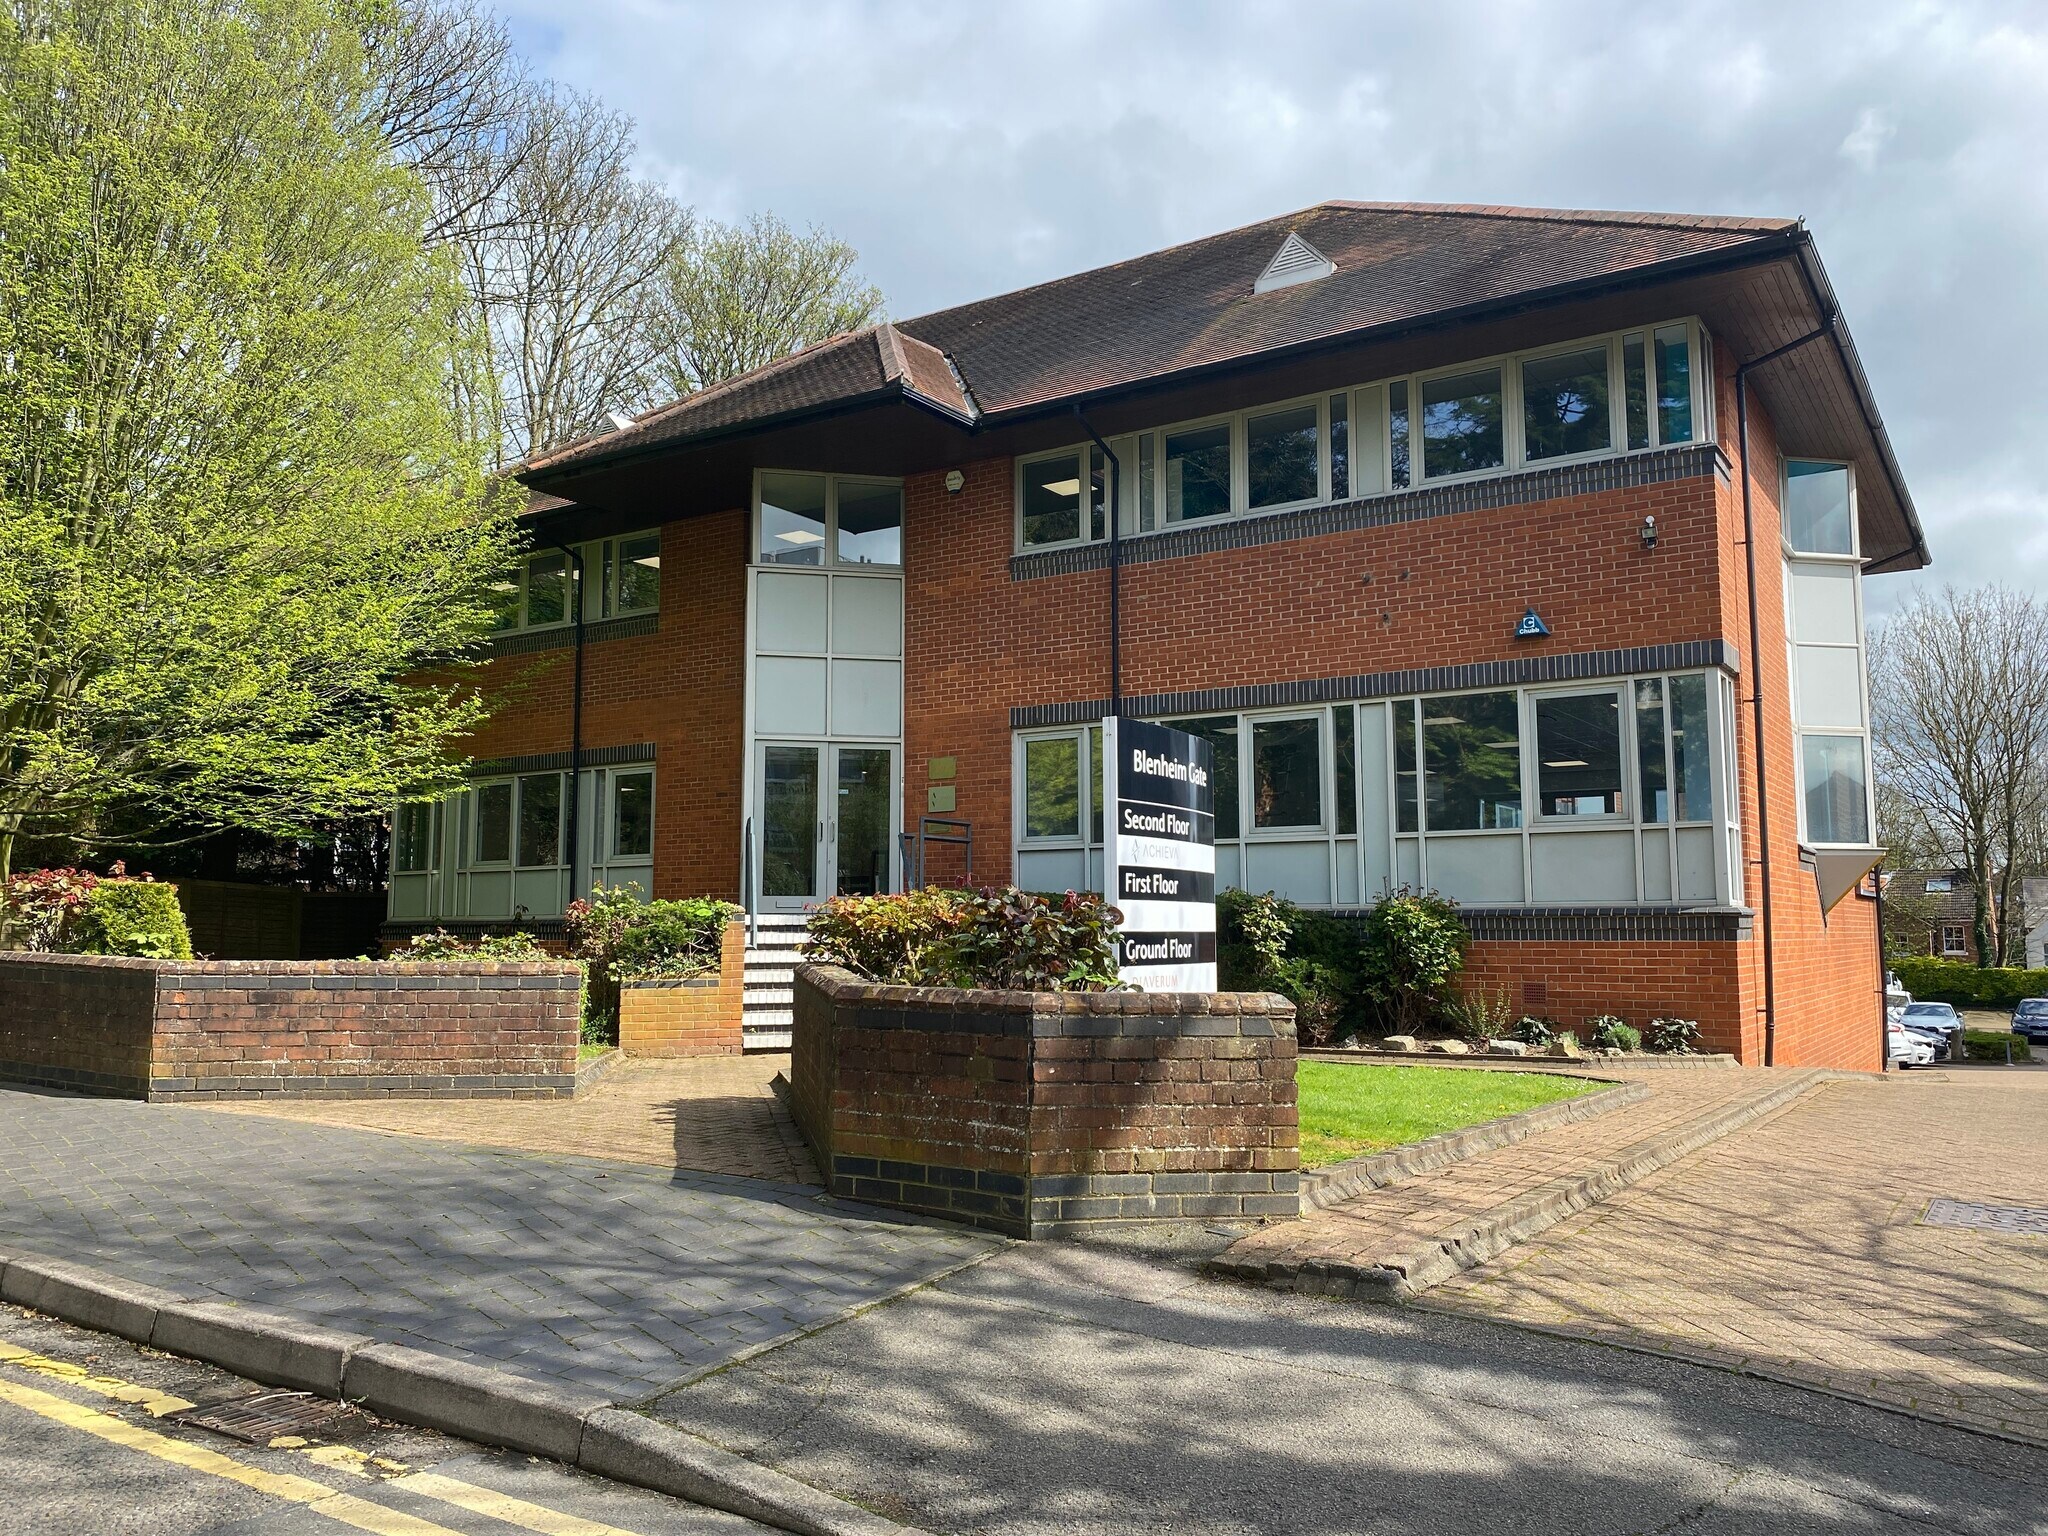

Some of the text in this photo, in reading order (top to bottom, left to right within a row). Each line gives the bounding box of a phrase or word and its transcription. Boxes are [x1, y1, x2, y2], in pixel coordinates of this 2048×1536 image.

[1519, 627, 1540, 635] Chubb
[1133, 748, 1207, 787] Blenheim Gate
[1124, 808, 1190, 836] Second Floor
[1125, 872, 1179, 895] First Floor
[1125, 938, 1193, 960] Ground Floor
